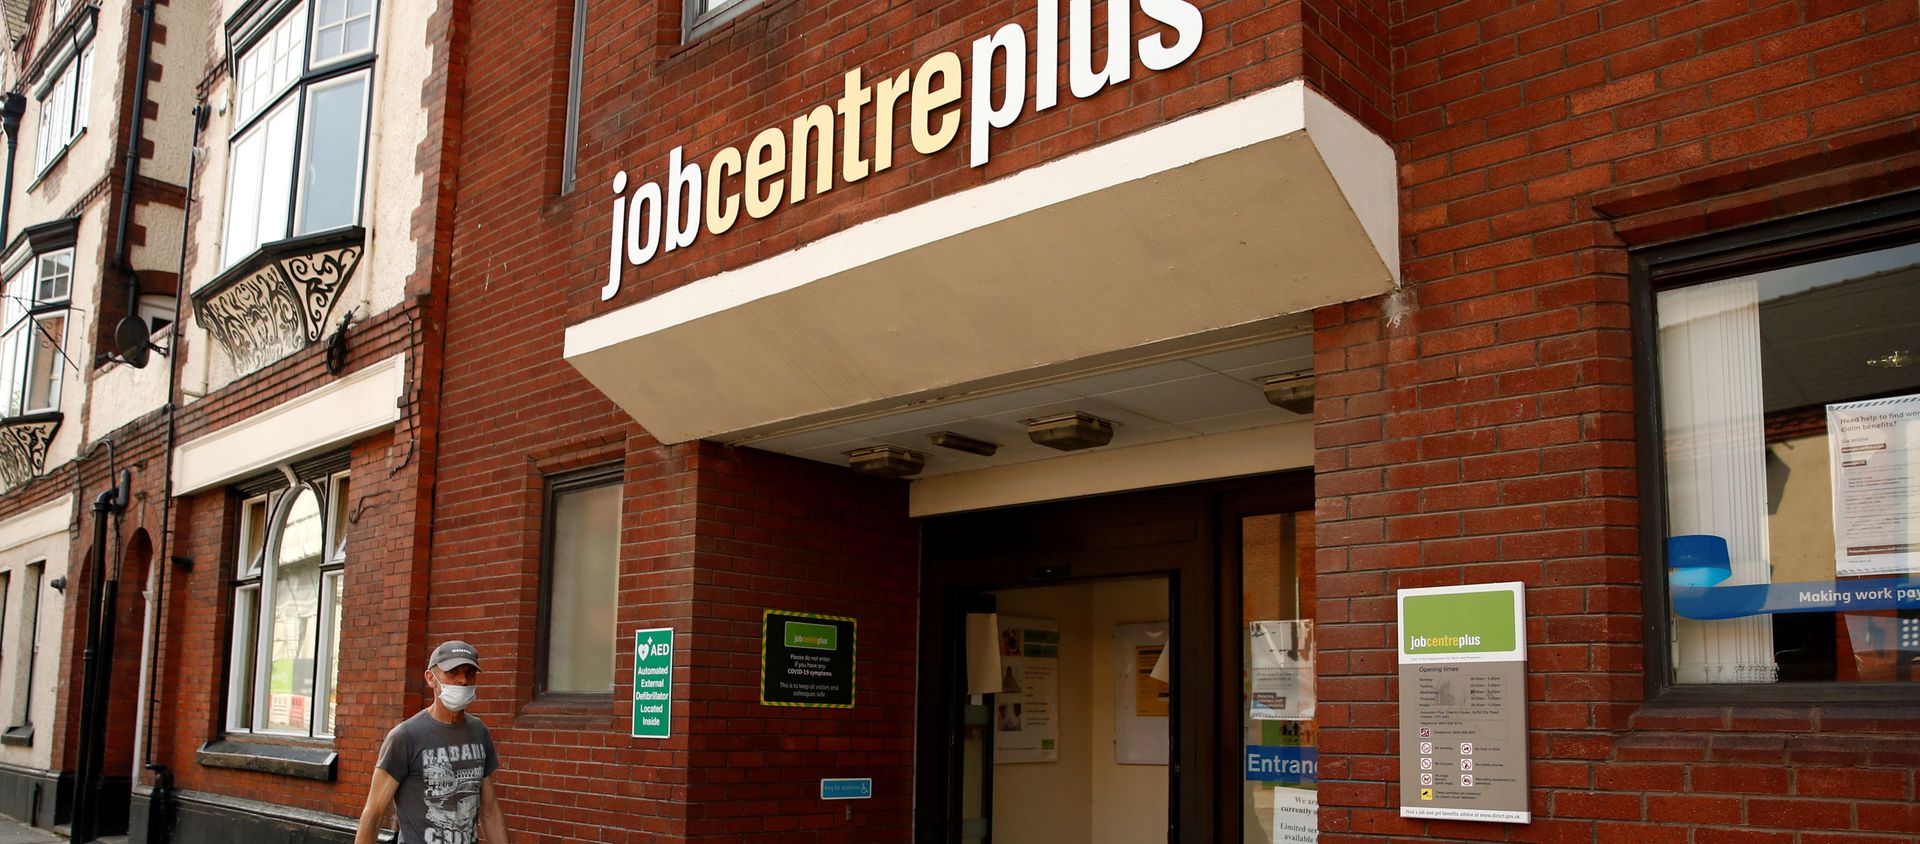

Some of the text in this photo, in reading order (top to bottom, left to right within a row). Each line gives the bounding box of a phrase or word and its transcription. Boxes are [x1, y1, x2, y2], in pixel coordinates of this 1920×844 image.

[602, 0, 1203, 301] jobcentreplus
[1841, 416, 1859, 425] Need
[1861, 414, 1877, 423] help
[1889, 411, 1904, 419] find
[1841, 420, 1897, 433] claim benefits?
[1799, 590, 1851, 604] Making
[1855, 587, 1893, 600] work
[1410, 633, 1481, 650] jobcentreplus
[650, 643, 670, 656] AED
[790, 653, 804, 661] Please
[637, 665, 669, 676] Automated
[810, 669, 832, 677] symptoms
[640, 679, 665, 688] External
[635, 691, 669, 701] Defibrillator
[640, 704, 664, 713] Located
[642, 717, 660, 726] Inside
[1294, 796, 1306, 804] We
[1281, 806, 1311, 816] currently
[1280, 822, 1306, 832] Limited
[1284, 834, 1314, 843] available
